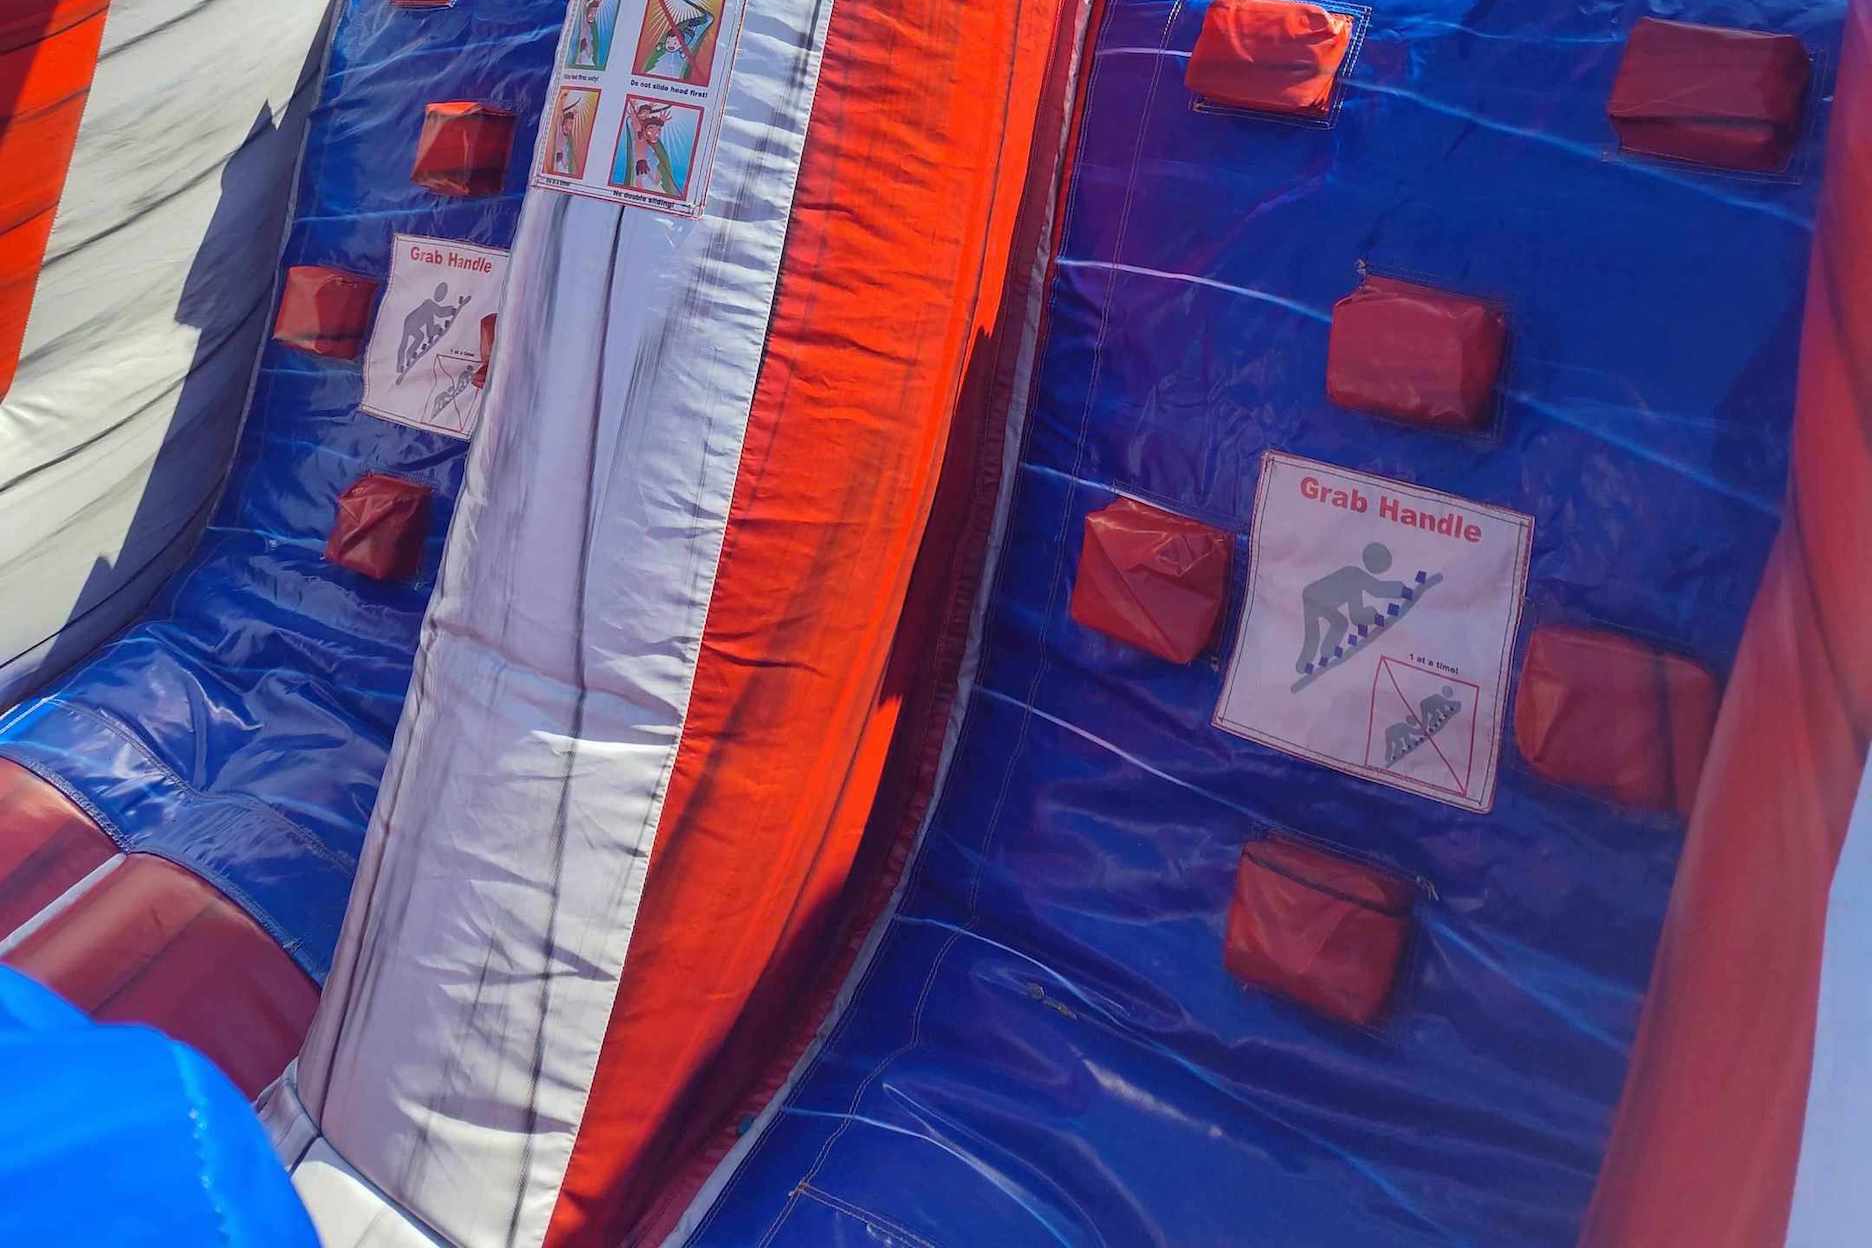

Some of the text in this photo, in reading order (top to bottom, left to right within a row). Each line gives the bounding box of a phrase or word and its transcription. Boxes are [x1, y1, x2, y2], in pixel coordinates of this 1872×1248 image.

[652, 84, 668, 92] slide
[670, 86, 688, 95] head
[690, 90, 708, 98] first!
[410, 246, 492, 273] Grab Handle
[1300, 476, 1482, 543] Grab Handle
[1416, 656, 1426, 664] at
[1436, 661, 1459, 675] time!
